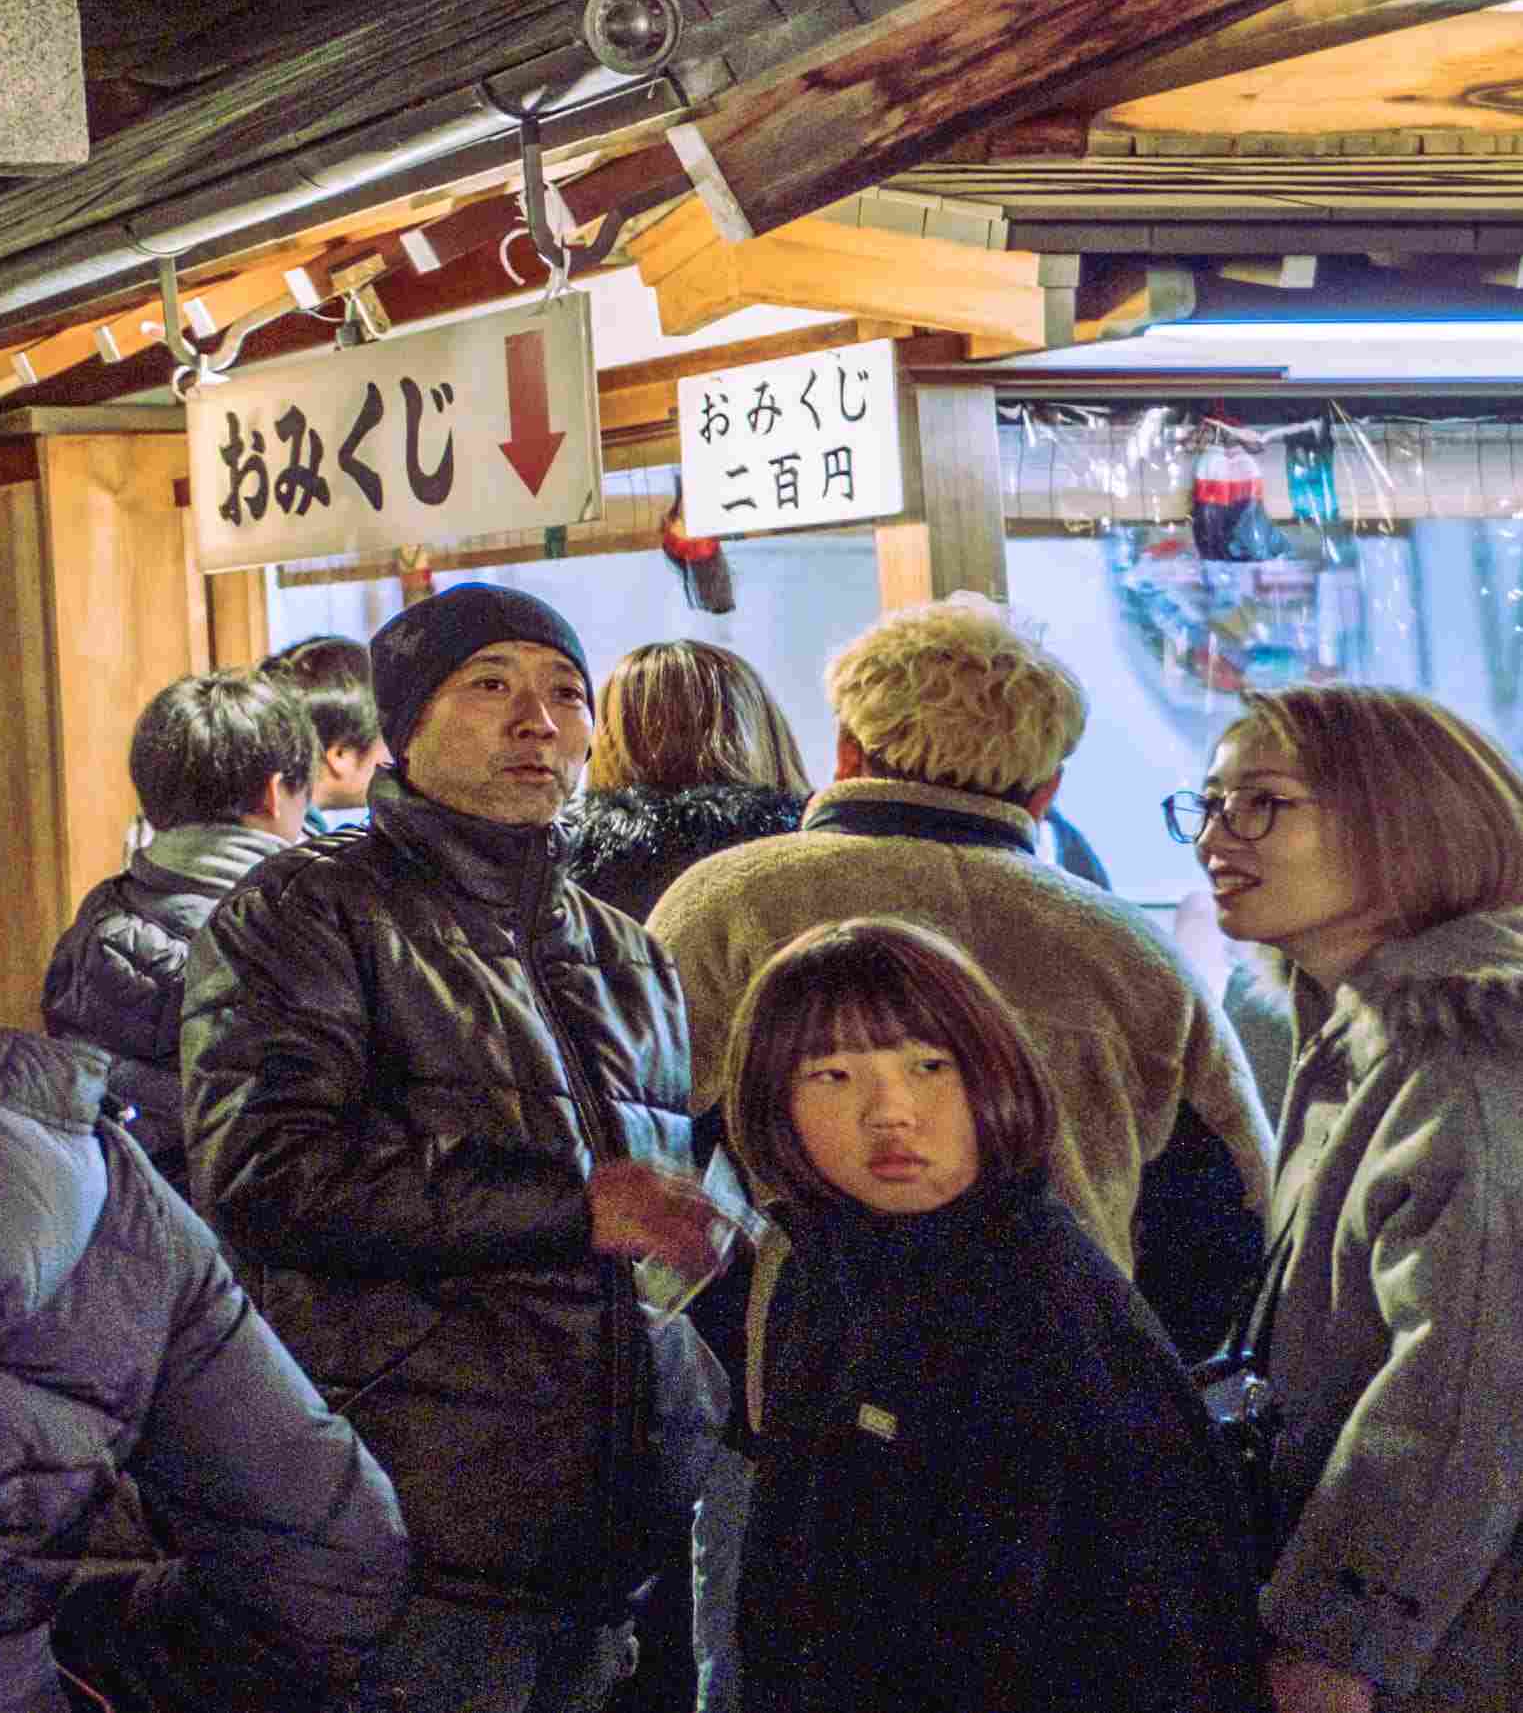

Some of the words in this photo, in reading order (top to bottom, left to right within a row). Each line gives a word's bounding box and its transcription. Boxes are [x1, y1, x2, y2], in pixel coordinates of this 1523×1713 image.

[699, 366, 870, 445] おみくじ
[218, 375, 456, 527] おみくじ
[721, 445, 854, 512] 二百円
